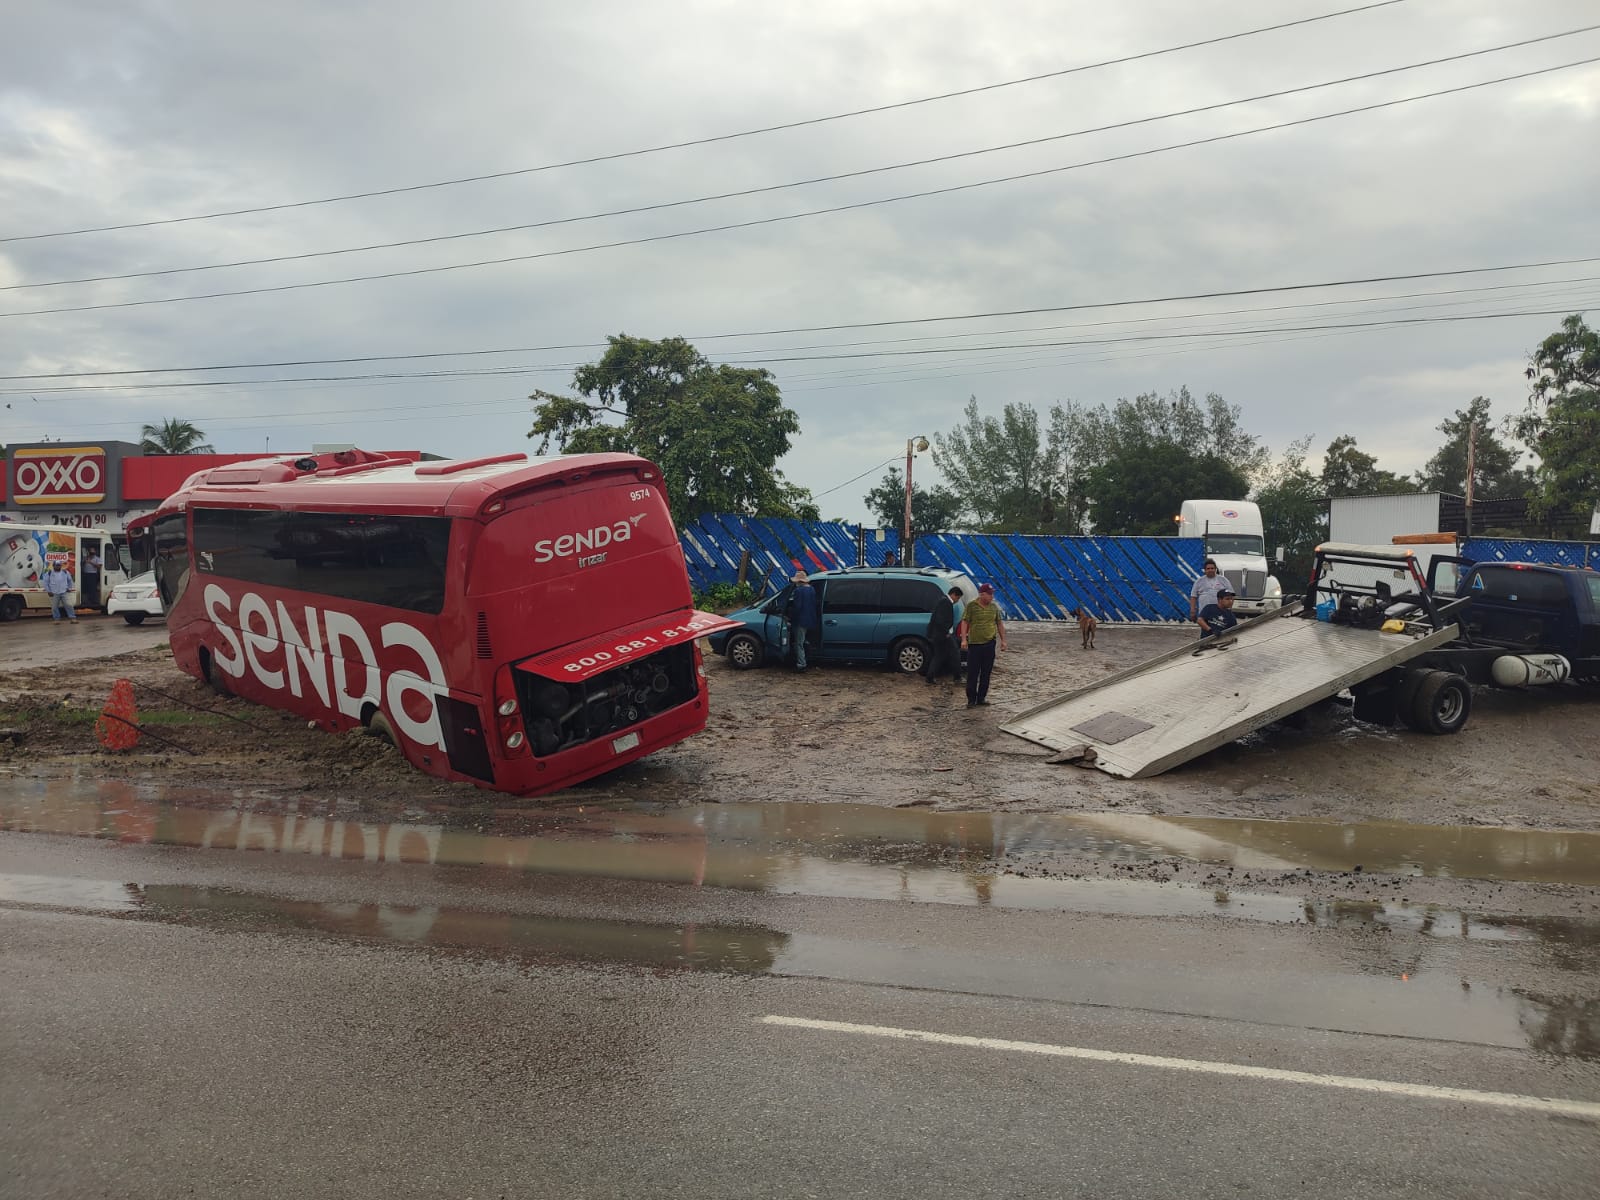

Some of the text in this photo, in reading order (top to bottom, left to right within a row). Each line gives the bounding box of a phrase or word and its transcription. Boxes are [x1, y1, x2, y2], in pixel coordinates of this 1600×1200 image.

[17, 457, 100, 496] OXXO
[630, 488, 650, 501] 9574
[578, 551, 607, 568] irizar
[563, 651, 612, 672] 800
[614, 636, 658, 653] 881
[662, 619, 717, 638] 8181
